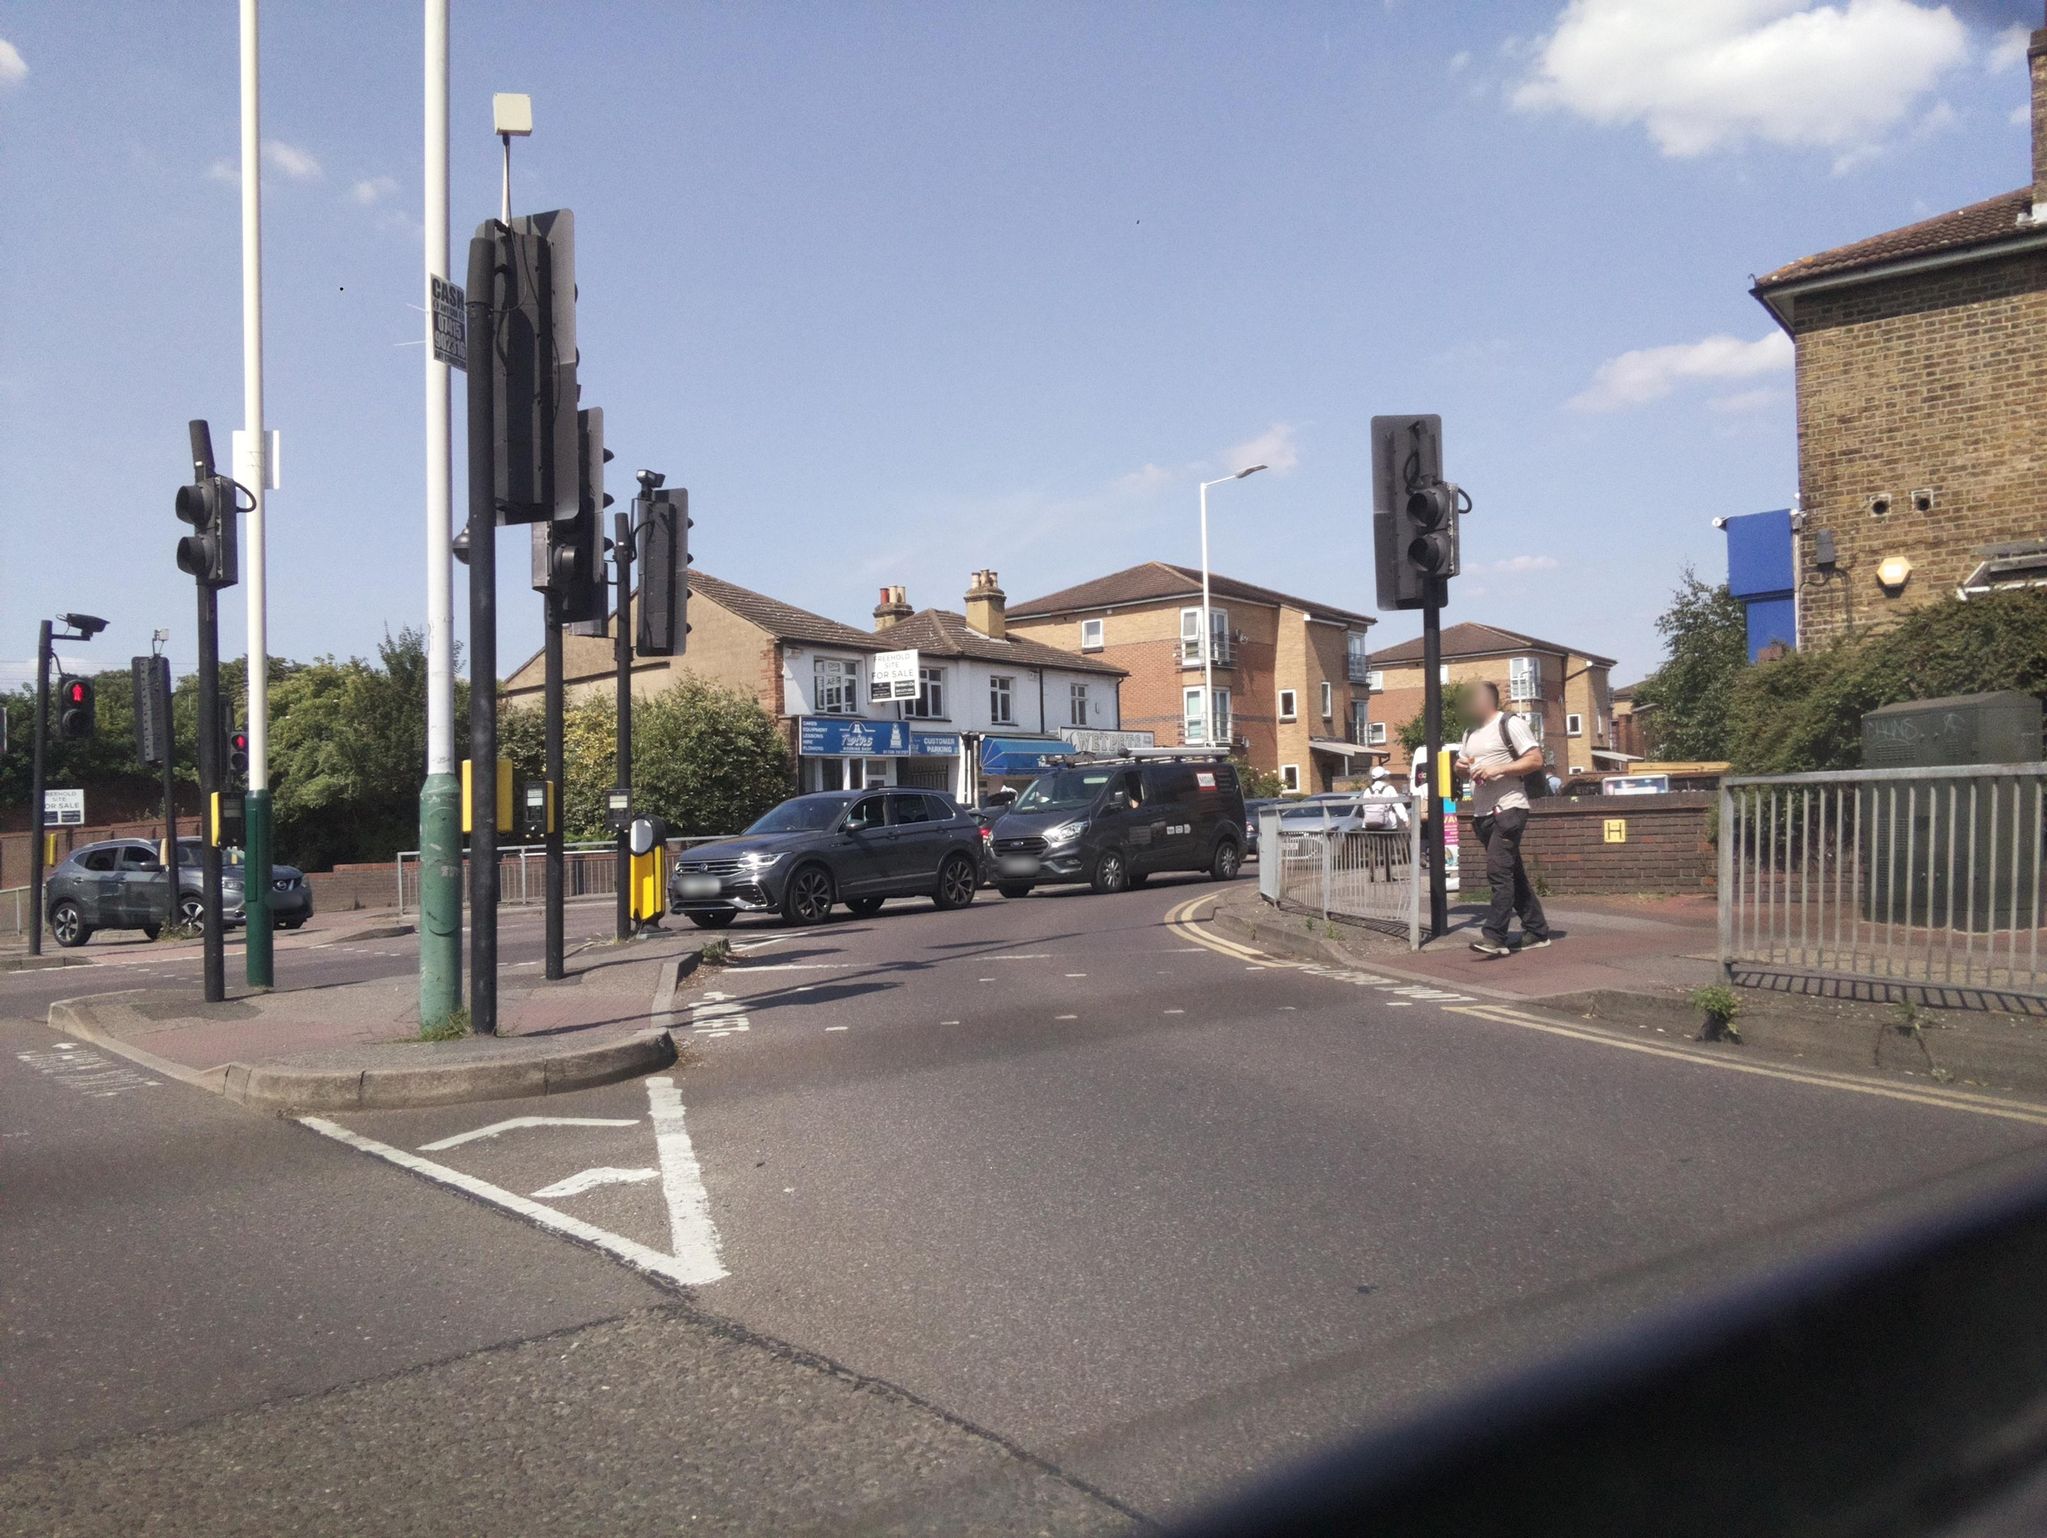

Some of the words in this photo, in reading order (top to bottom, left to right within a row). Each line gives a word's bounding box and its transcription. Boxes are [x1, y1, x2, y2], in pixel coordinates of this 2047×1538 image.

[432, 278, 465, 311] CASH
[872, 653, 910, 662] FREEHOLD
[872, 671, 889, 680] FOR
[892, 669, 914, 678] SALE
[923, 737, 955, 745] CUSTOMER
[1607, 822, 1622, 840] H
